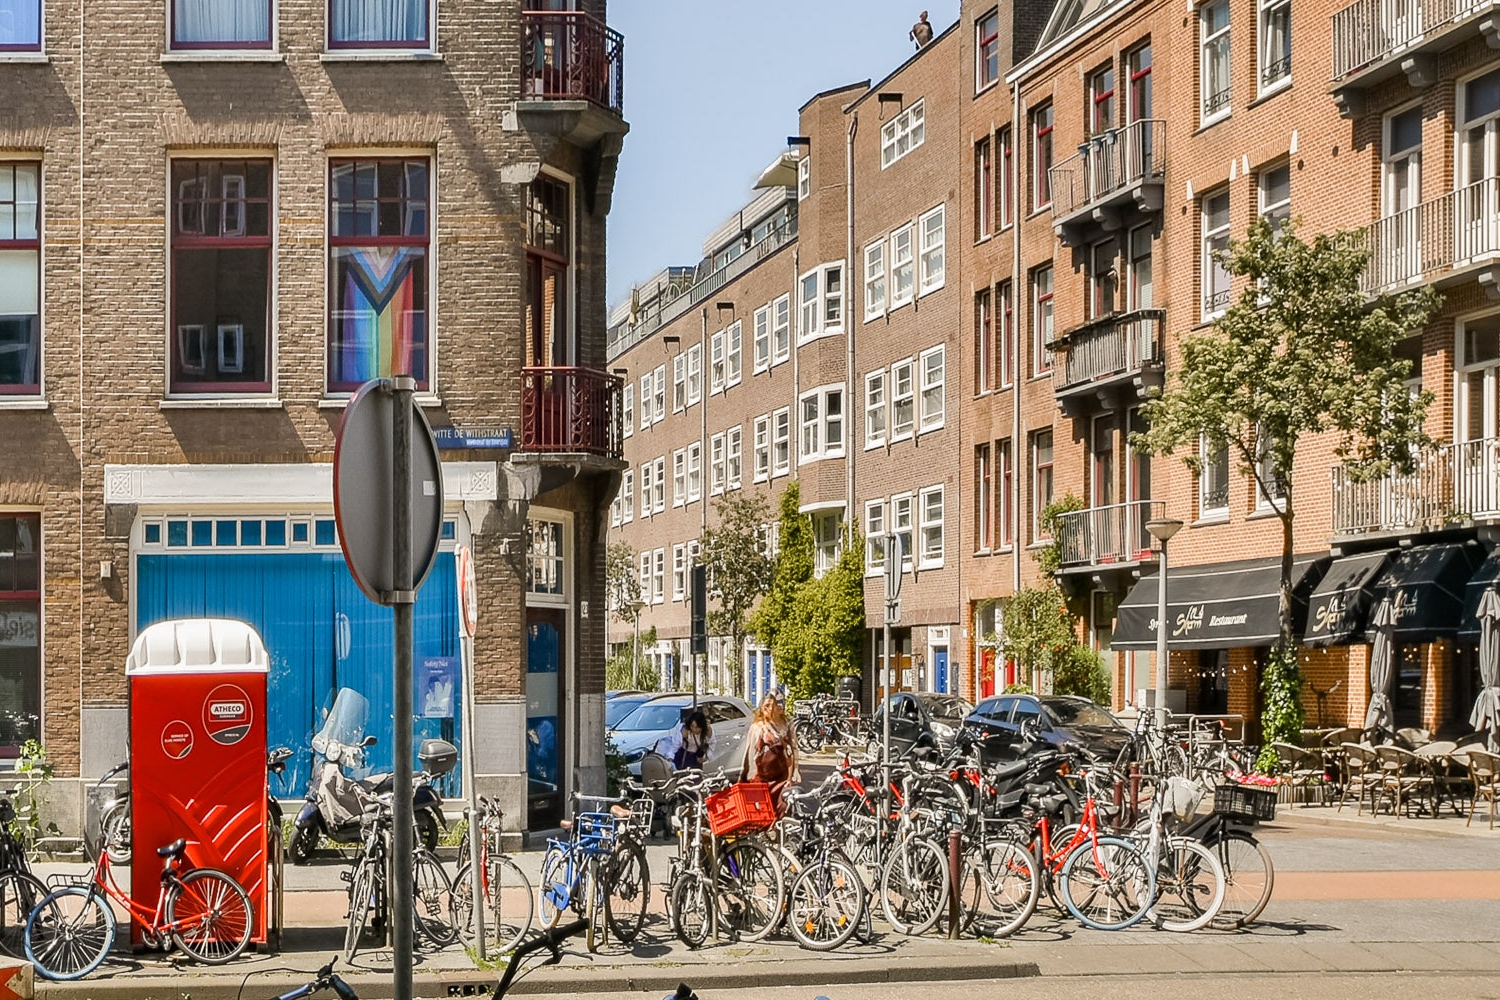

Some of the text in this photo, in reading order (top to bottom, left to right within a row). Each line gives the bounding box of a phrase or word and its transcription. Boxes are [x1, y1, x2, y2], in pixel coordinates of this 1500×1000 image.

[454, 428, 464, 439] DE
[466, 428, 508, 438] WITHSTRAAT
[1208, 613, 1248, 627] Restaurant
[214, 705, 242, 713] ATHECO
